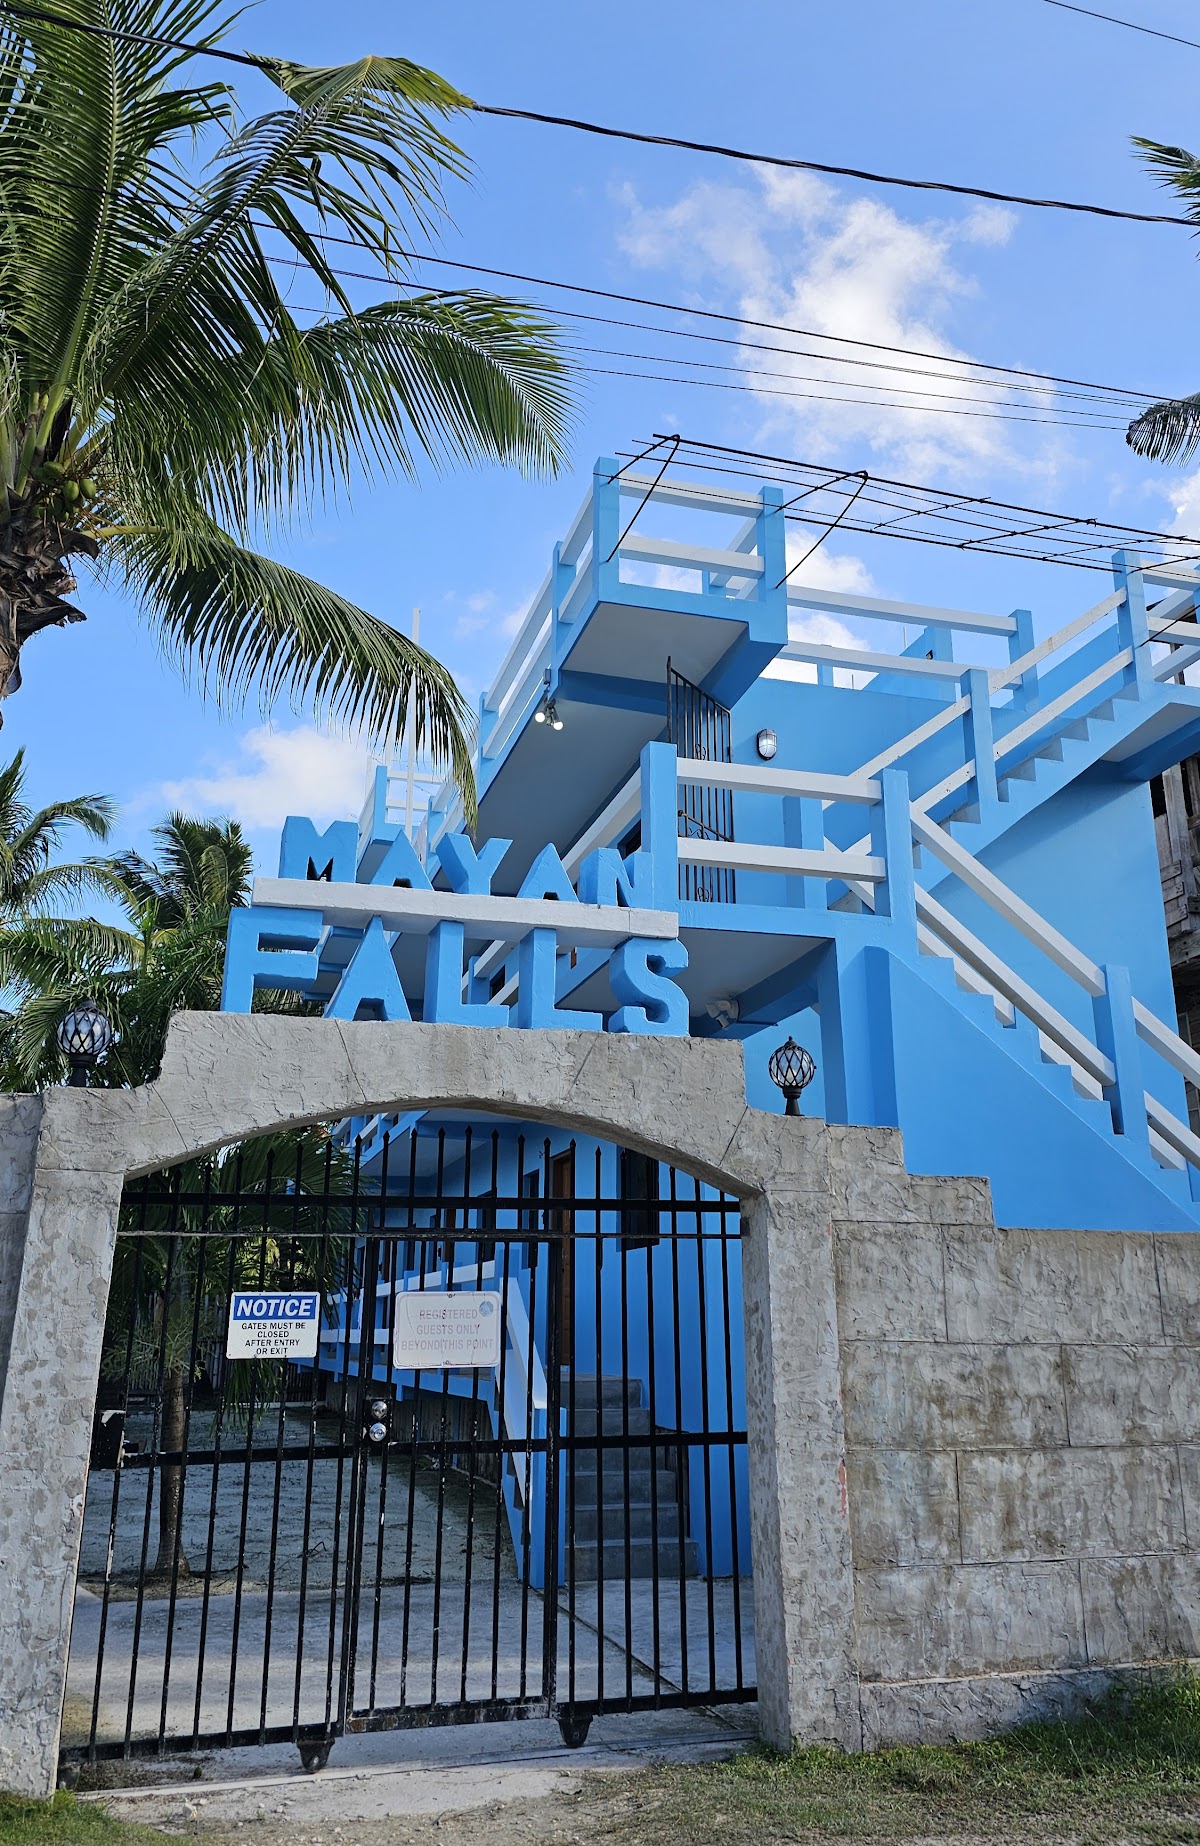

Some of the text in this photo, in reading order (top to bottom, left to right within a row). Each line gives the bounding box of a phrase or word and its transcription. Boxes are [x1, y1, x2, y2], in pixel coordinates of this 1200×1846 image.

[278, 815, 653, 909] MAYAN
[220, 907, 689, 1038] FALLS
[236, 1298, 314, 1317] NOTICE
[419, 1309, 478, 1320] REGISTERED
[241, 1322, 306, 1330] GATES MUST BE
[416, 1323, 480, 1335] GUESTS ONLY
[257, 1330, 290, 1338] CLOSED
[244, 1339, 272, 1347] AFTER
[401, 1338, 494, 1351] BEYOND THIS POINT
[256, 1347, 288, 1355] OR EXIT
